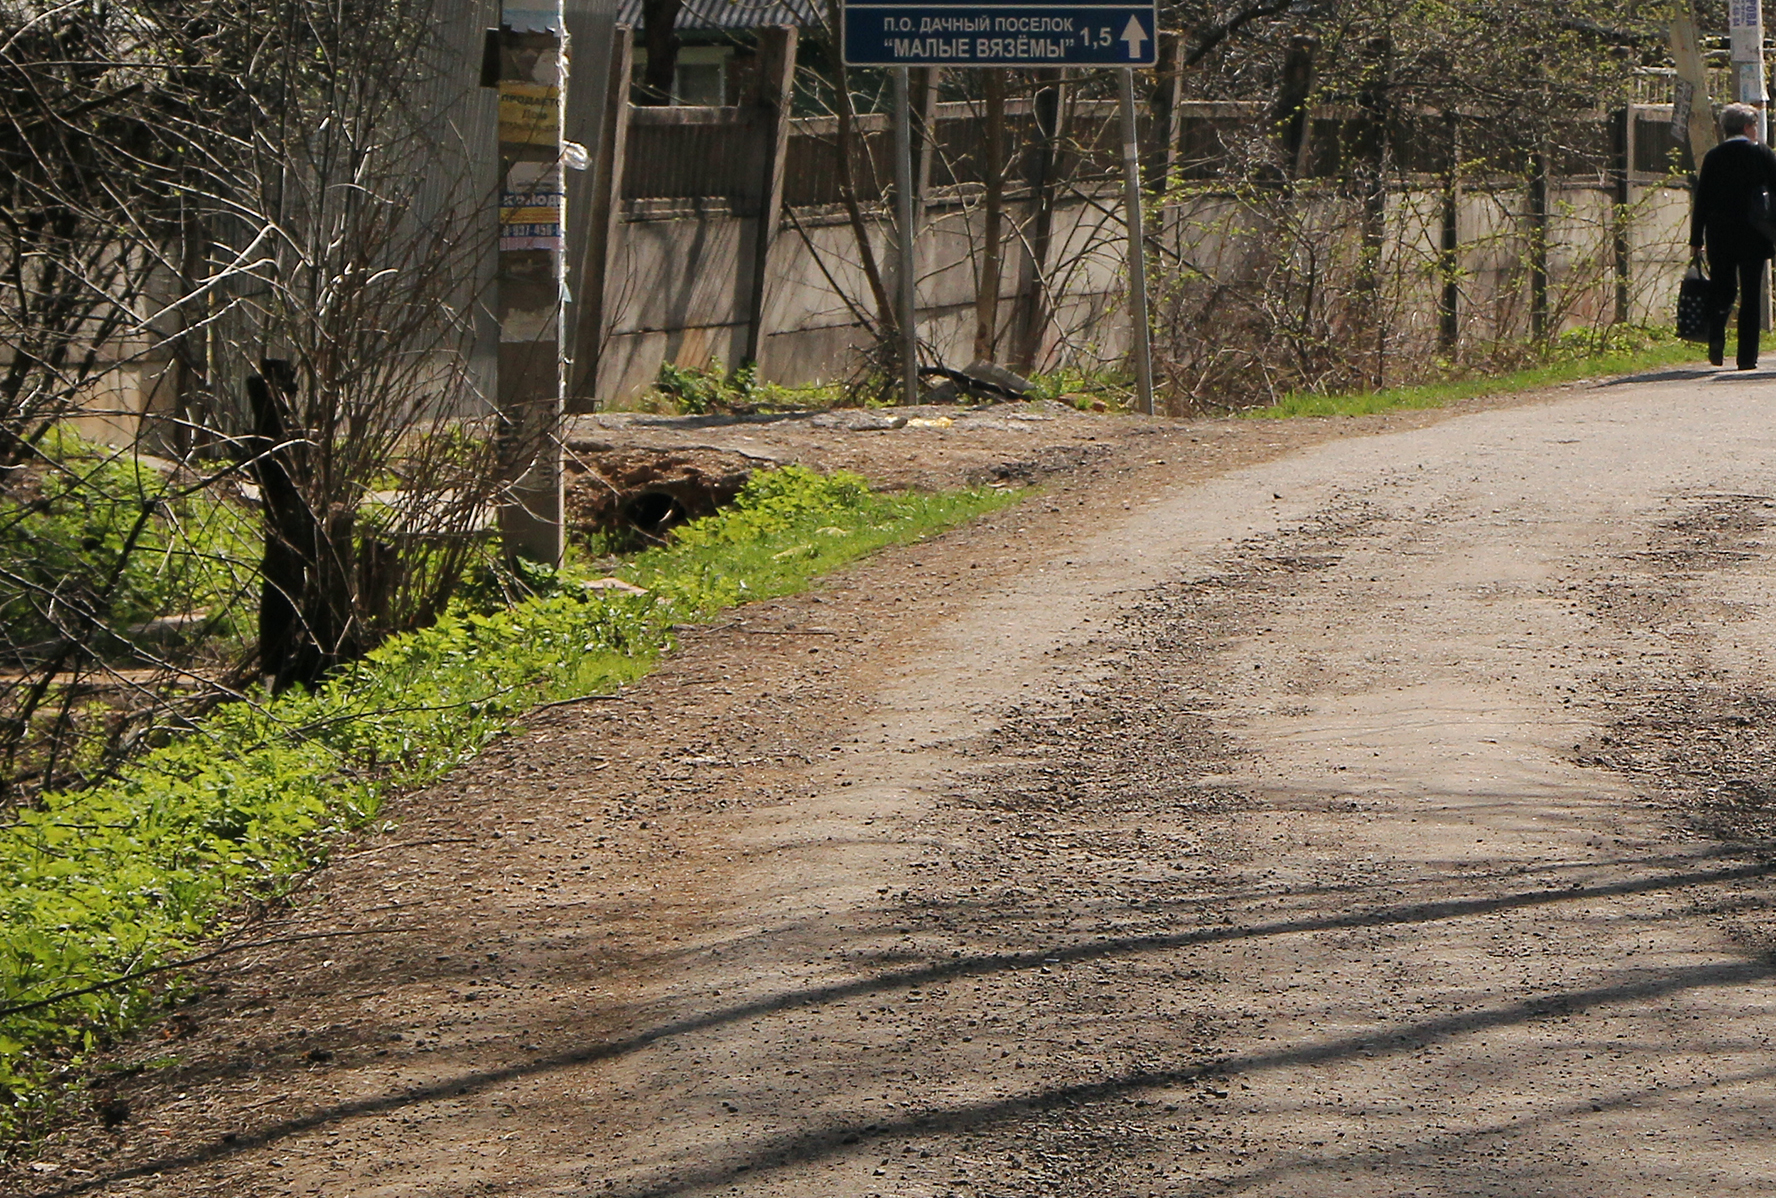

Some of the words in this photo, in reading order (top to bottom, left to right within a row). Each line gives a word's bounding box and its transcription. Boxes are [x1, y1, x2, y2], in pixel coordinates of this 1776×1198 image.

[884, 18, 916, 32] П.О.
[919, 14, 990, 33] ДАЧНЫЙ
[995, 17, 1073, 32] ПОСЕЛОК
[884, 38, 970, 57] “МАЛЫЕ
[976, 35, 1075, 58] ВЯЗЁМЫ”
[1079, 28, 1112, 50] 1,5
